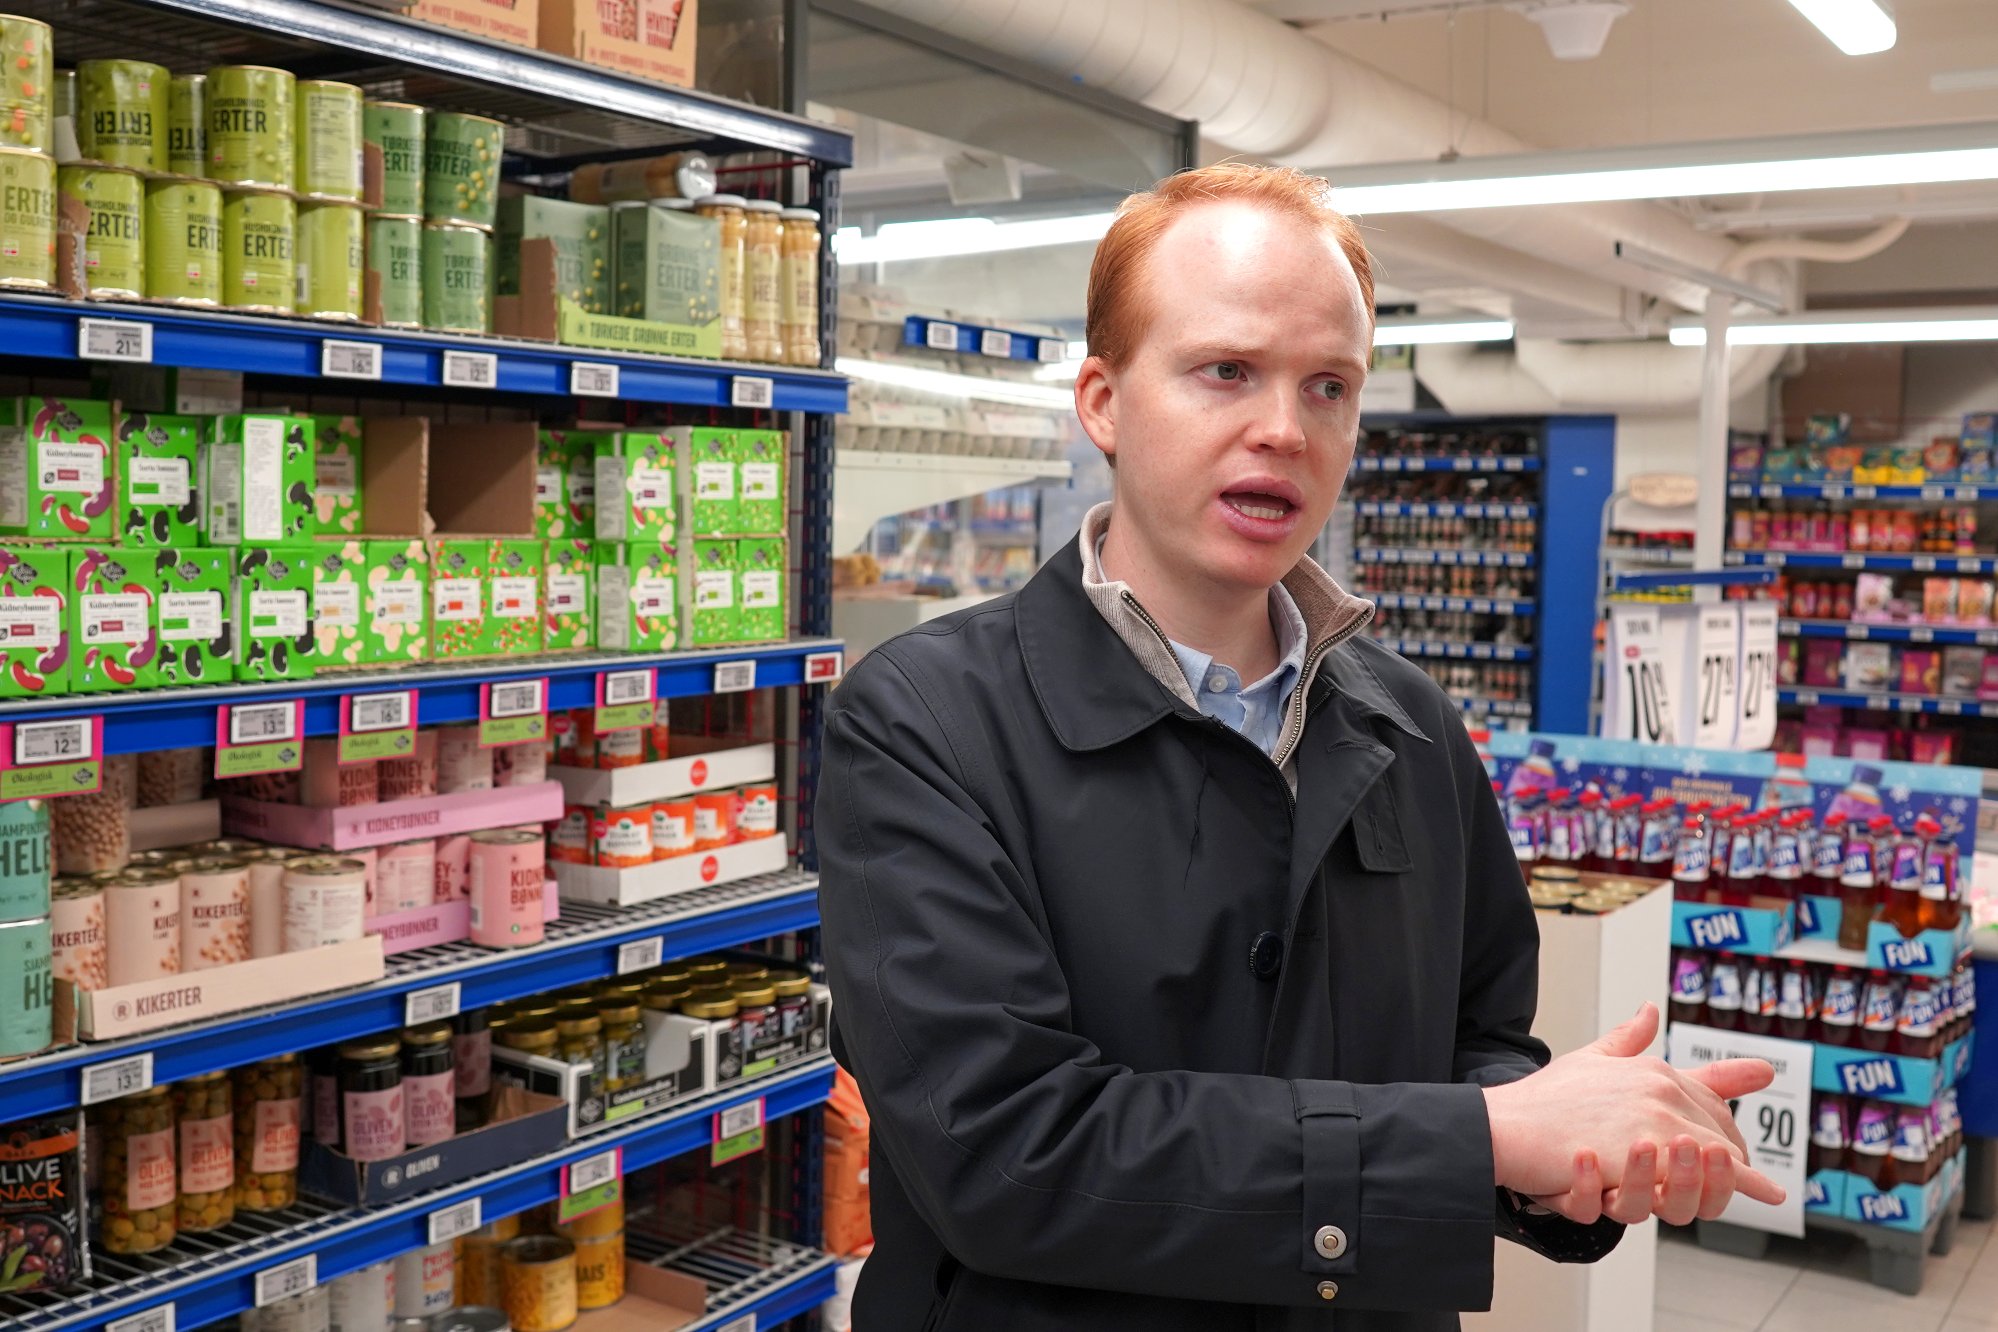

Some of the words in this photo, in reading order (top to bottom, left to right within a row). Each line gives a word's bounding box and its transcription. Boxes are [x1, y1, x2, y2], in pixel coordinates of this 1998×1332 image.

[94, 111, 152, 134] ERTER
[212, 109, 268, 134] ERTER
[589, 321, 631, 342] TØRKEDE
[632, 326, 669, 346] GRØNNE
[670, 330, 697, 348] ERTER
[54, 738, 70, 754] 12
[1690, 911, 1742, 948] FUN
[1884, 940, 1928, 968] FUN
[24, 969, 51, 1012] HE
[1680, 973, 1703, 993] FUN
[136, 986, 201, 1018] KIKERTER
[1842, 1060, 1897, 1094] FUN
[1759, 1104, 1794, 1148] 90
[1861, 1121, 1889, 1143] FUN
[0, 1157, 61, 1185] LIVE
[405, 1154, 440, 1179] OLIVEN
[1861, 1194, 1904, 1220] FUN
[577, 1264, 605, 1283] AIS
